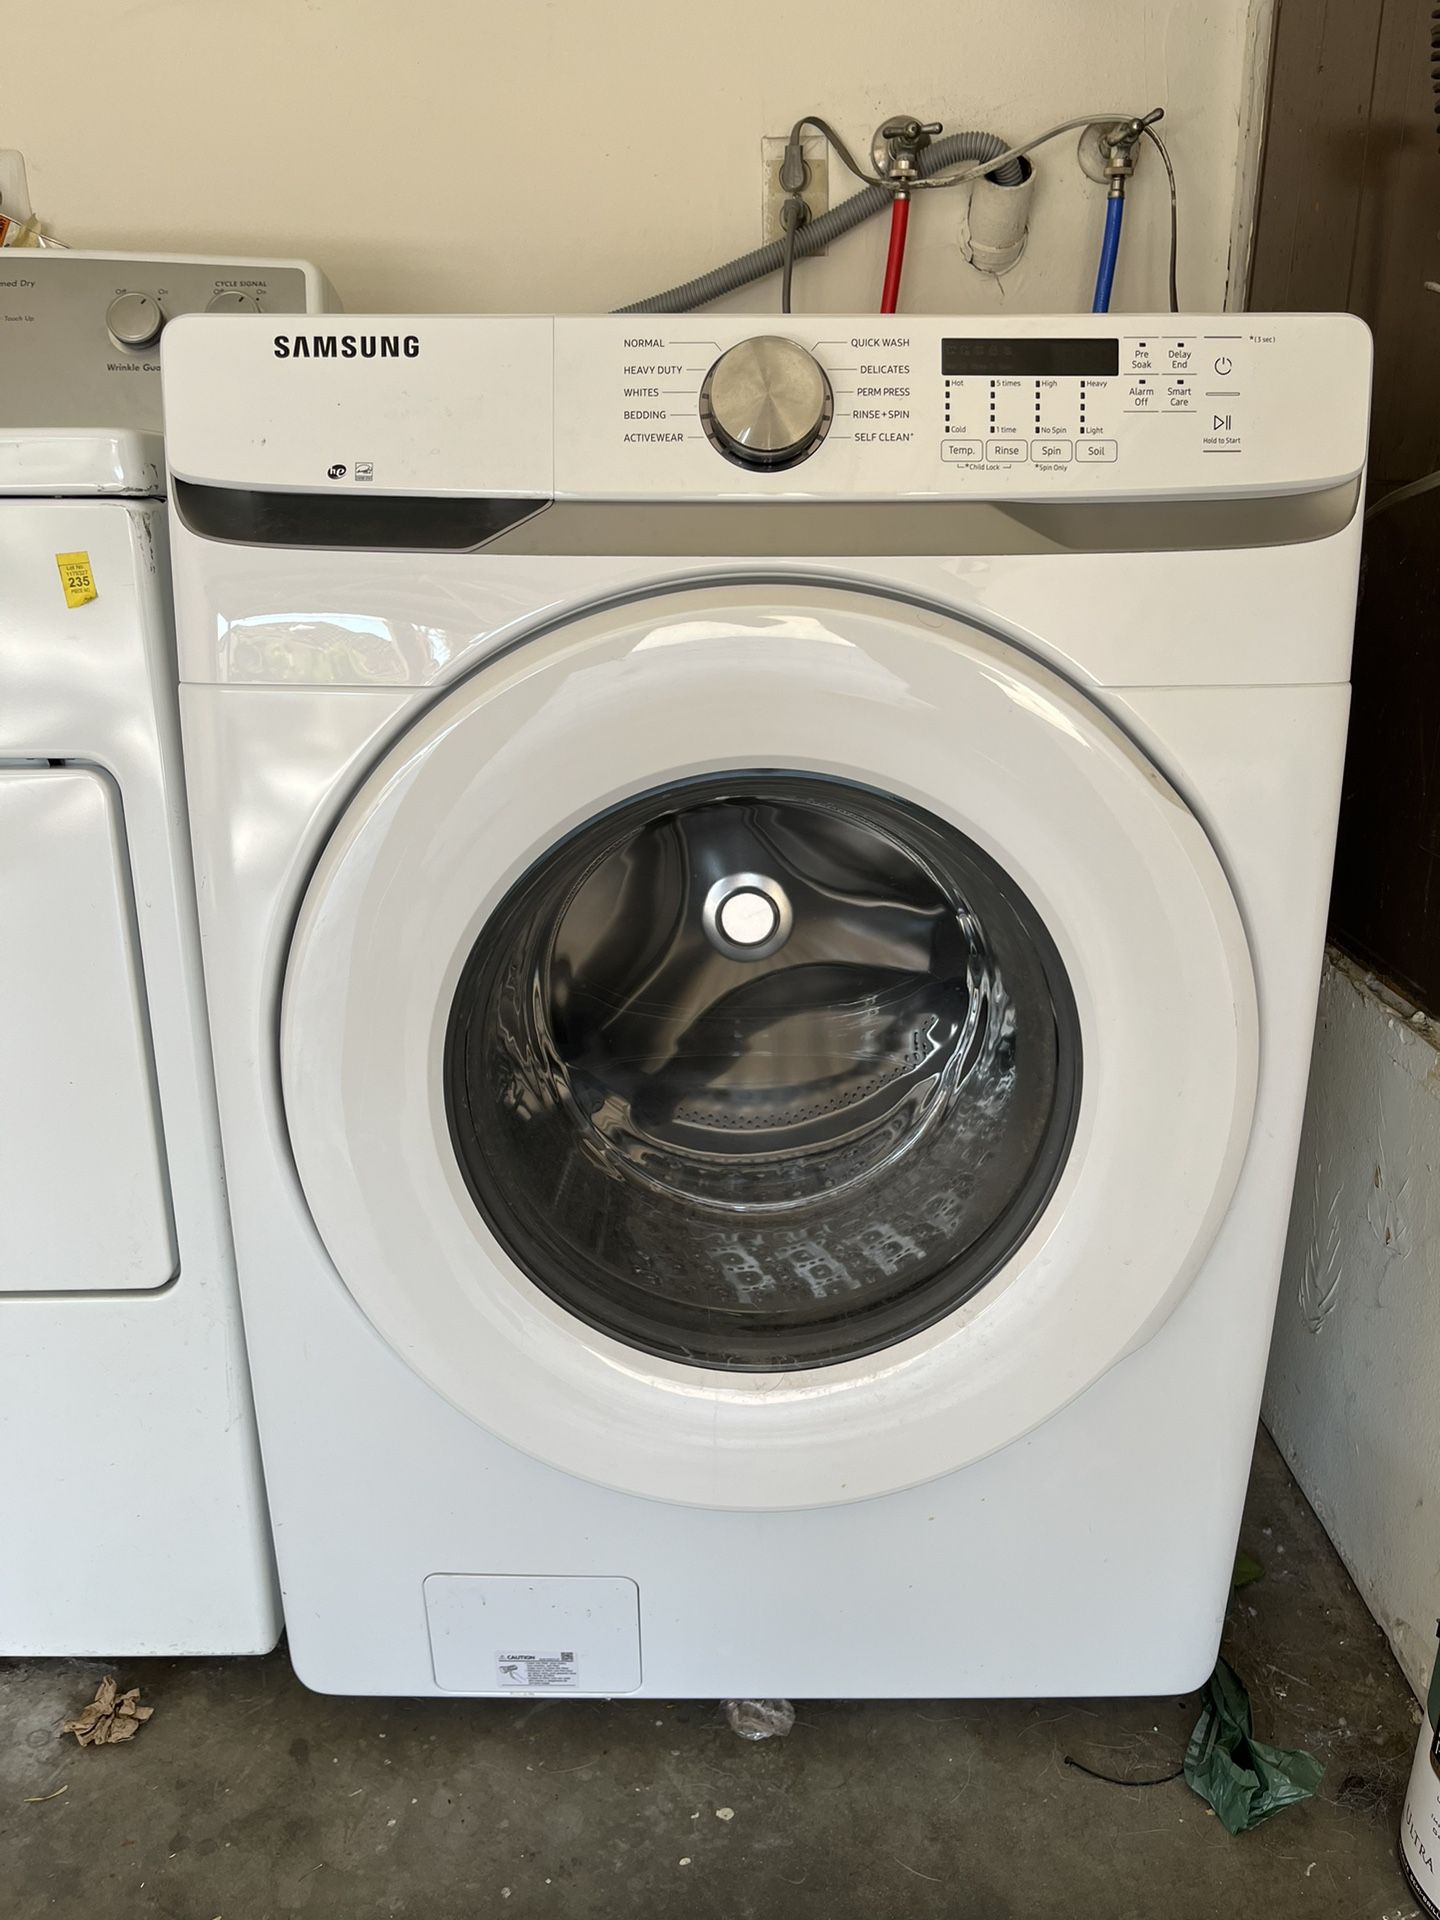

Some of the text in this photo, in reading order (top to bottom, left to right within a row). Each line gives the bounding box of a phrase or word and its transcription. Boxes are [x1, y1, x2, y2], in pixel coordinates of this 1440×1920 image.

[20, 280, 36, 288] Dry
[274, 335, 420, 358] SAMSUNG
[623, 339, 665, 348] NORMAL
[850, 338, 910, 348] QUICK WASH
[1134, 350, 1149, 359] Pre
[1168, 350, 1192, 361] Delay
[107, 363, 140, 372] Wrinkle
[1131, 360, 1152, 369] Soak
[1172, 360, 1188, 369] End
[623, 366, 683, 375] HEAVY DUTY
[860, 365, 910, 374] DELICATES
[1041, 380, 1058, 388] High
[1086, 380, 1108, 388] Heavy
[623, 388, 659, 397] WHITES
[857, 388, 911, 396] PERM PRESS
[1129, 387, 1154, 396] Alarm
[1167, 387, 1192, 396] Smart
[1134, 397, 1149, 406] Off
[1170, 398, 1189, 406] Care
[623, 410, 667, 420] BEDDING
[852, 410, 880, 419] RINSE
[888, 410, 910, 419] SPIN
[1041, 426, 1067, 435] No Spin
[1086, 426, 1104, 435] Light
[623, 433, 684, 442] ACTIVEWEAR
[854, 433, 877, 442] SELF
[949, 446, 976, 456] Temp.
[994, 446, 1020, 455] Rinse
[1042, 446, 1062, 457] Spin
[1088, 447, 1105, 456] Soil
[986, 463, 1000, 471] Lock
[1053, 464, 1068, 472] Only
[68, 576, 90, 588] 235
[1405, 1803, 1434, 1874] ULTRA
